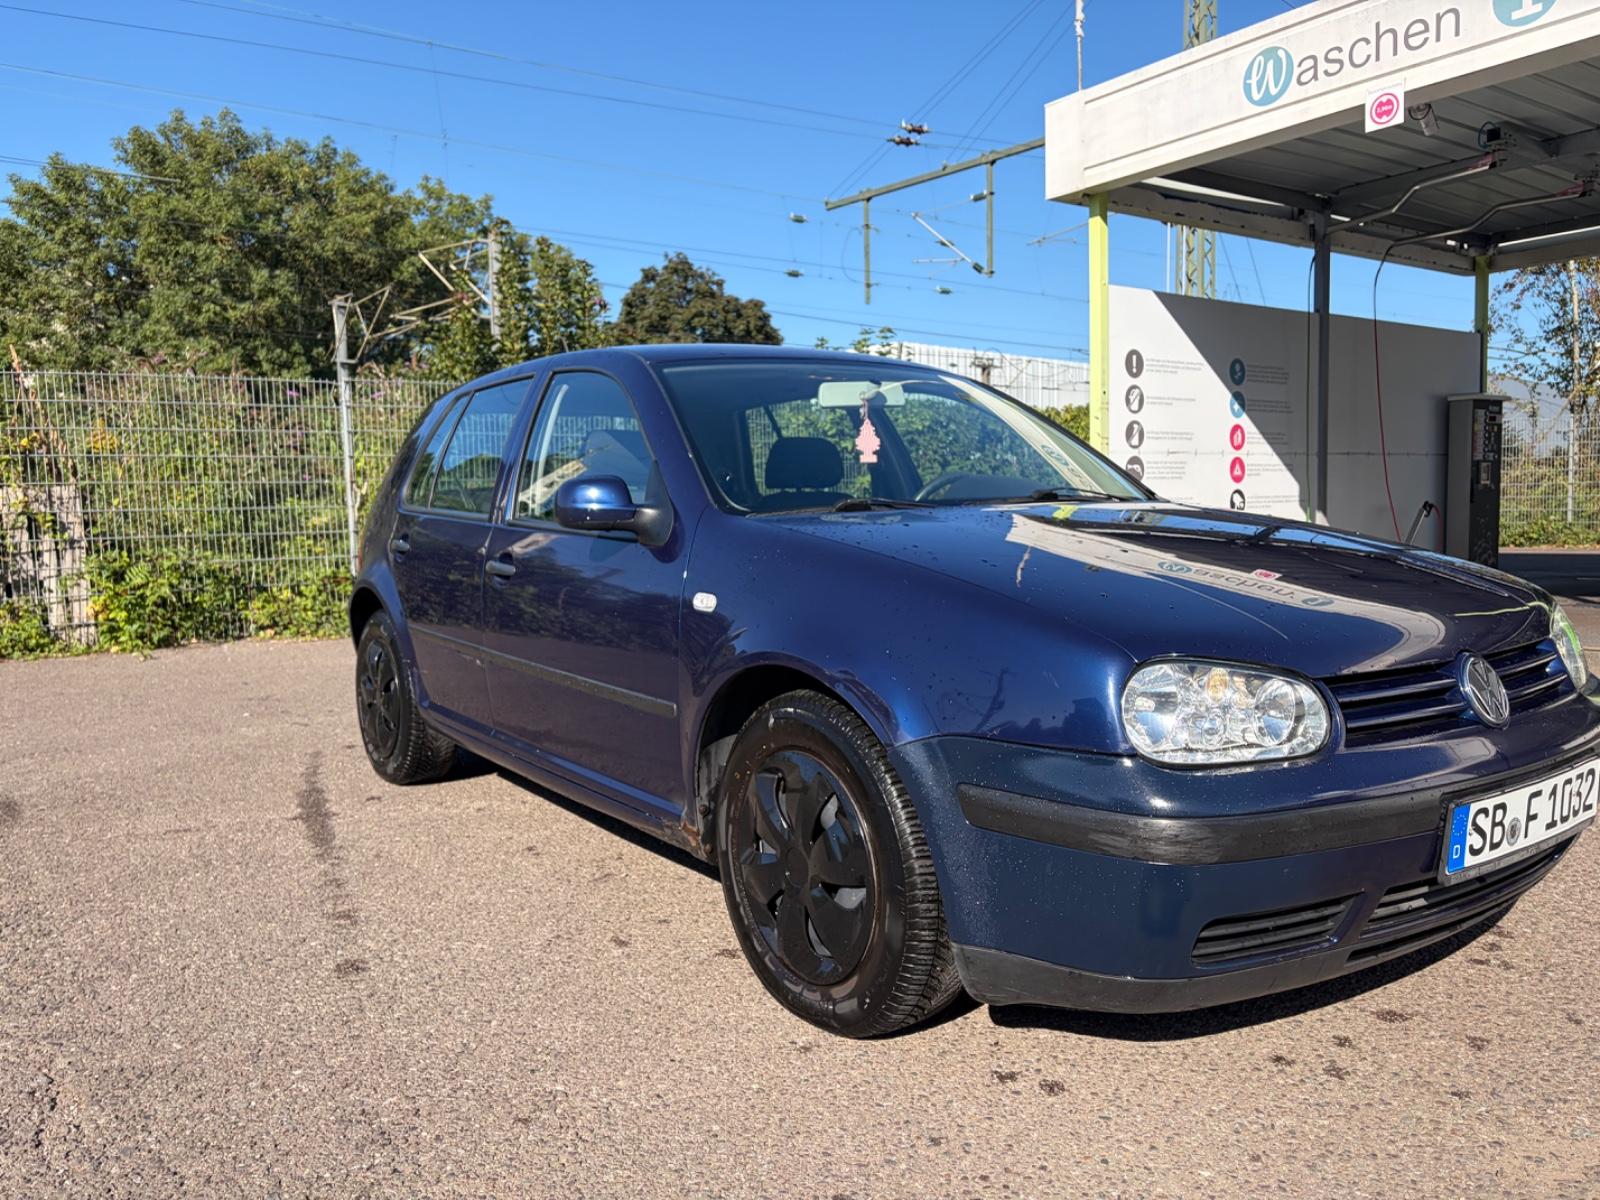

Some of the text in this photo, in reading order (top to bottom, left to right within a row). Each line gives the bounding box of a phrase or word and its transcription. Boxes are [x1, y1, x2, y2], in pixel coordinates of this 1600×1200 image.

[1245, 7, 1461, 103] Waschen
[1453, 845, 1460, 859] D
[1469, 767, 1596, 857] SB F 1032
